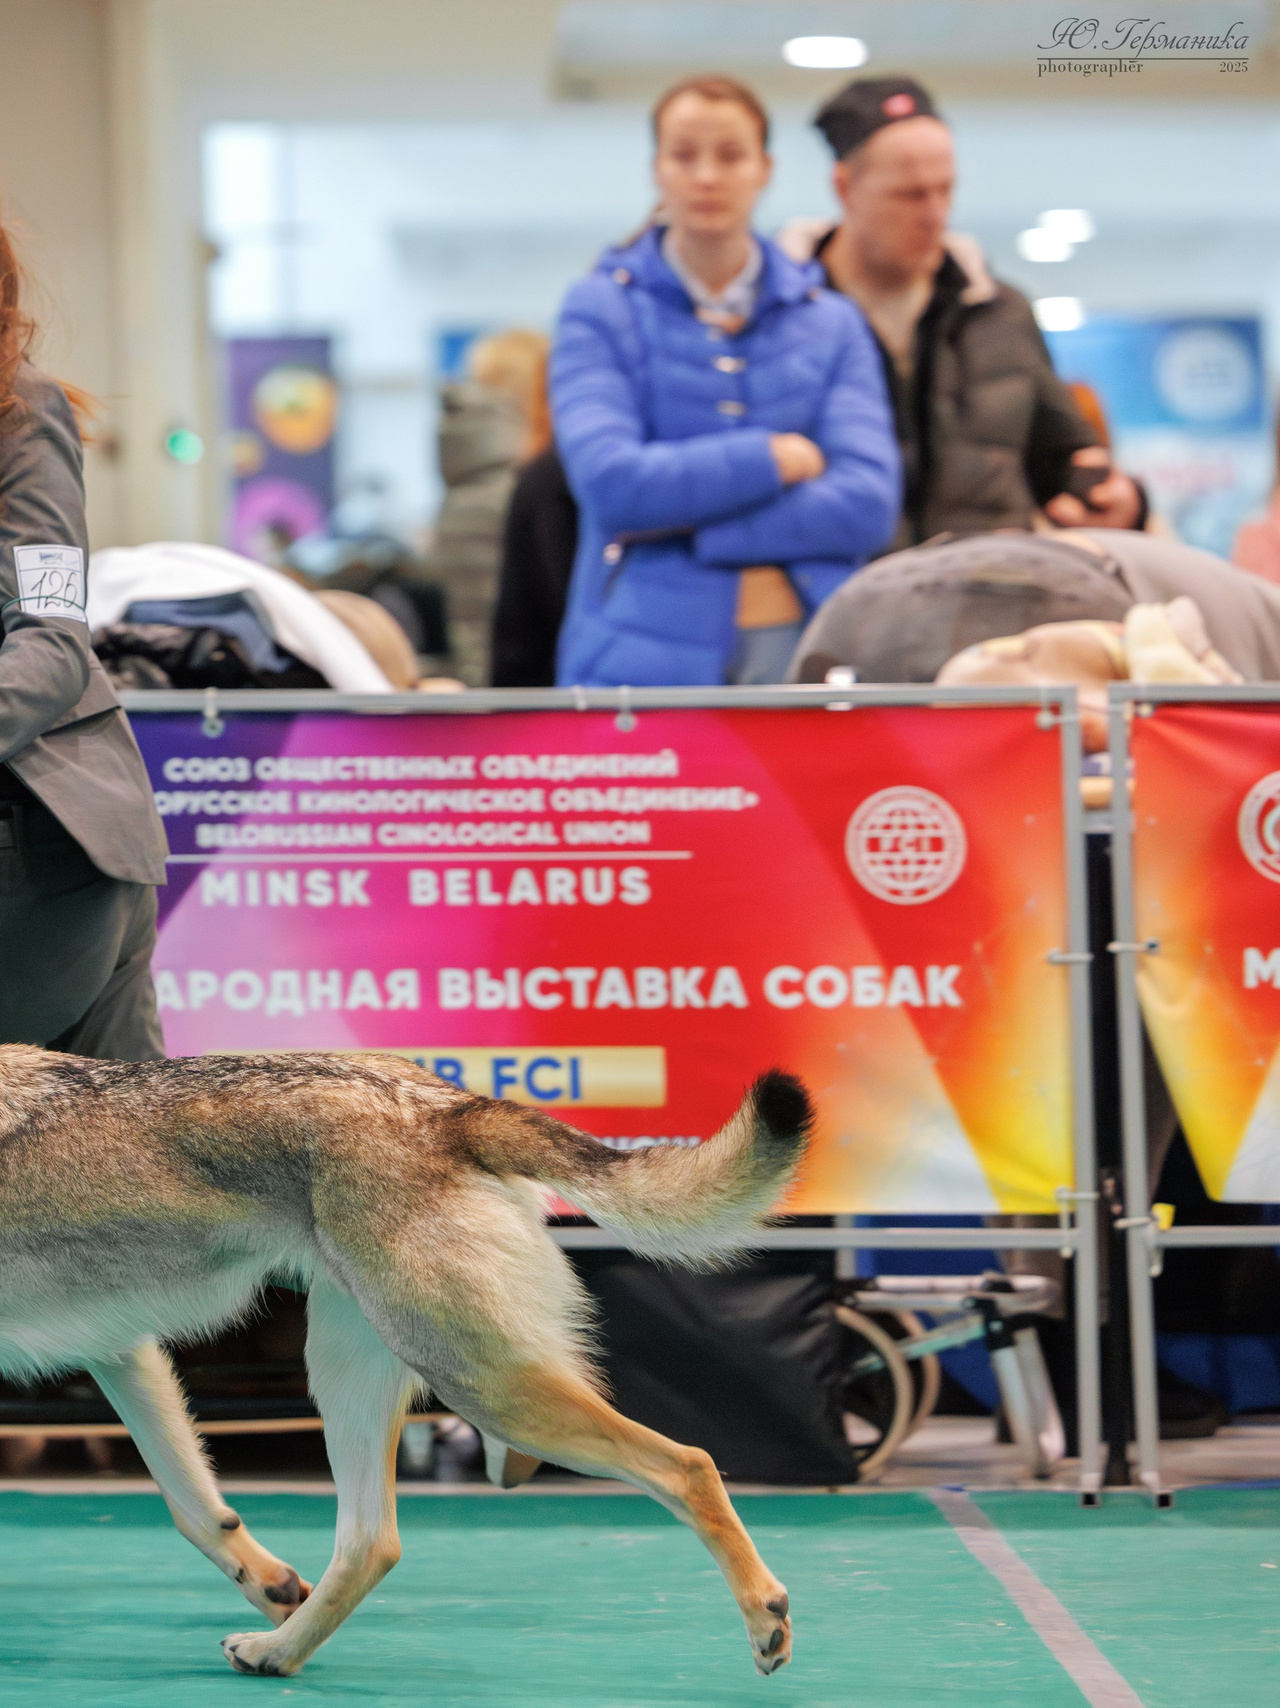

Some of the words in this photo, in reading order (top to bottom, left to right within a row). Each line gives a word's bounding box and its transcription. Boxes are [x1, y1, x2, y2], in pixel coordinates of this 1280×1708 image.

[31, 570, 77, 609] 126
[163, 757, 251, 782] СОЮЗ
[254, 756, 475, 783] ОБЩЕСТВЕННЫХ
[481, 750, 679, 780] ОБЪЕДИНЕНИЙ
[298, 789, 545, 814] КИНОЛОГИЧЕСКОЕ
[195, 823, 372, 848] BELORUSSIAN
[377, 822, 559, 846] CINOLOGICAL
[563, 821, 651, 845] UNION
[201, 869, 371, 906] MINSK
[409, 867, 651, 906] BELARUS
[157, 968, 419, 1017] АРОДНАЯ
[439, 966, 748, 1010] ВЫСТАВКА
[763, 965, 963, 1008] СОБАК
[491, 1056, 581, 1102] FCI
